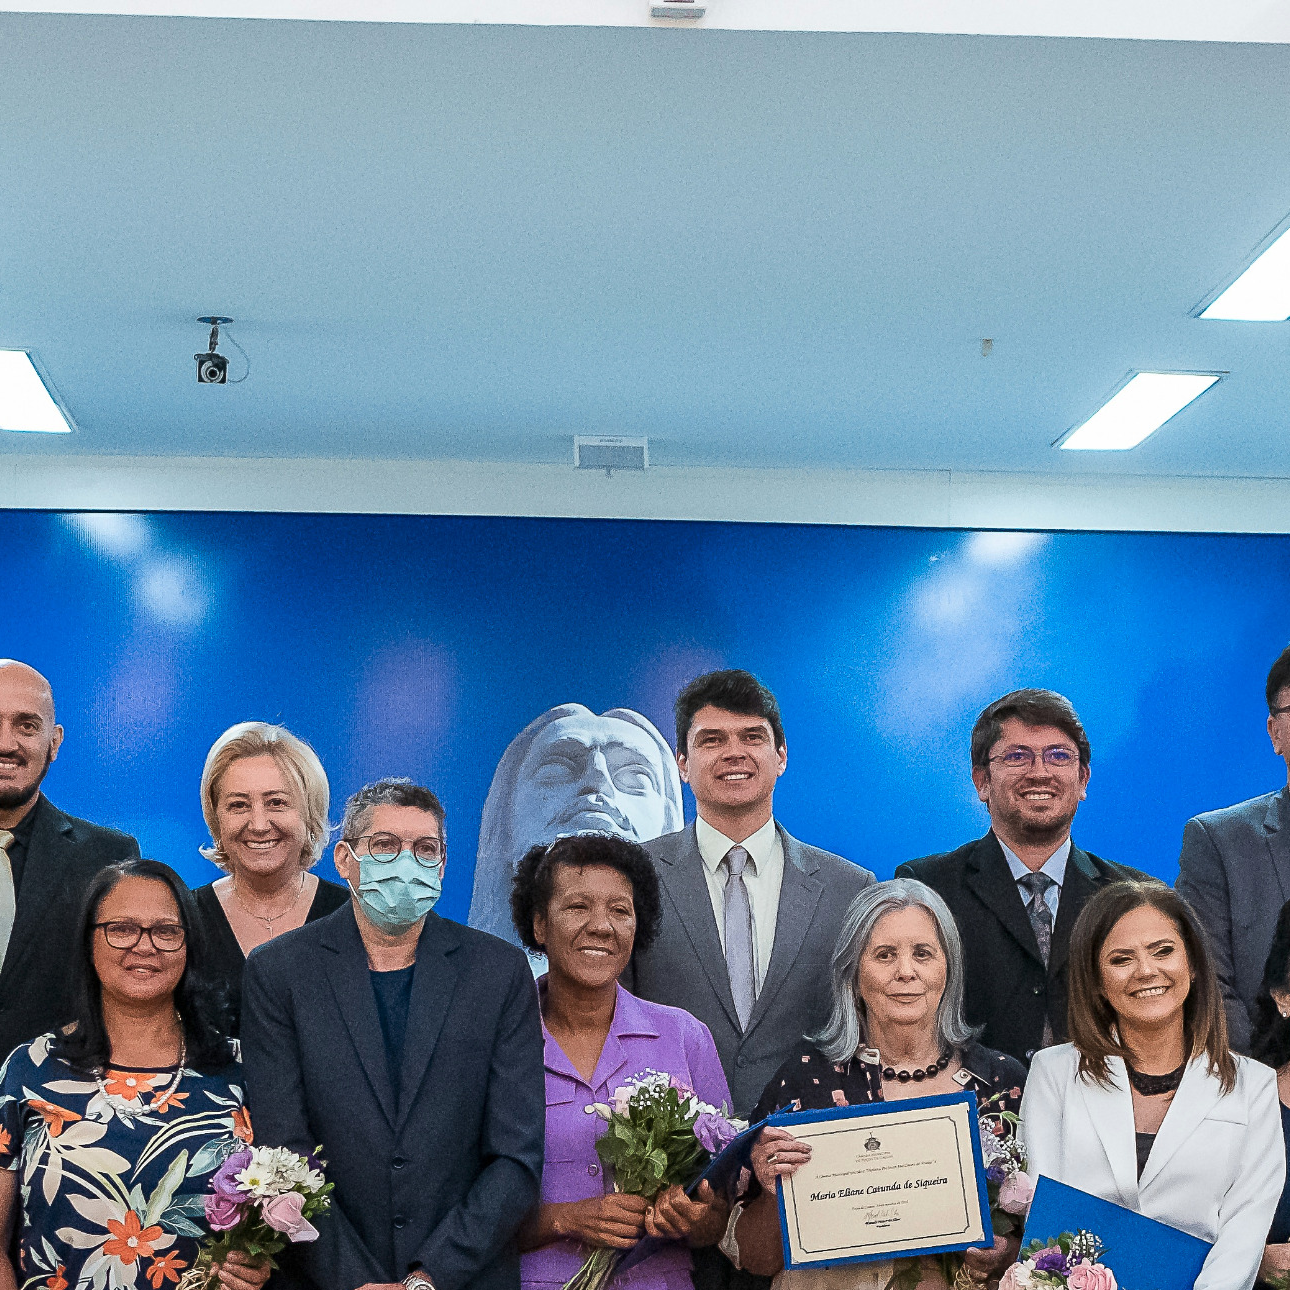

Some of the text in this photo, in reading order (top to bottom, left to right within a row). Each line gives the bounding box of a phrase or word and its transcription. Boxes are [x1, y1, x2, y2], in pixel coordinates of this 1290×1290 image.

[810, 1190, 836, 1202] Maria
[837, 1187, 865, 1198] Eliane
[903, 1180, 913, 1189] de
[914, 1176, 948, 1190] Siqueira
